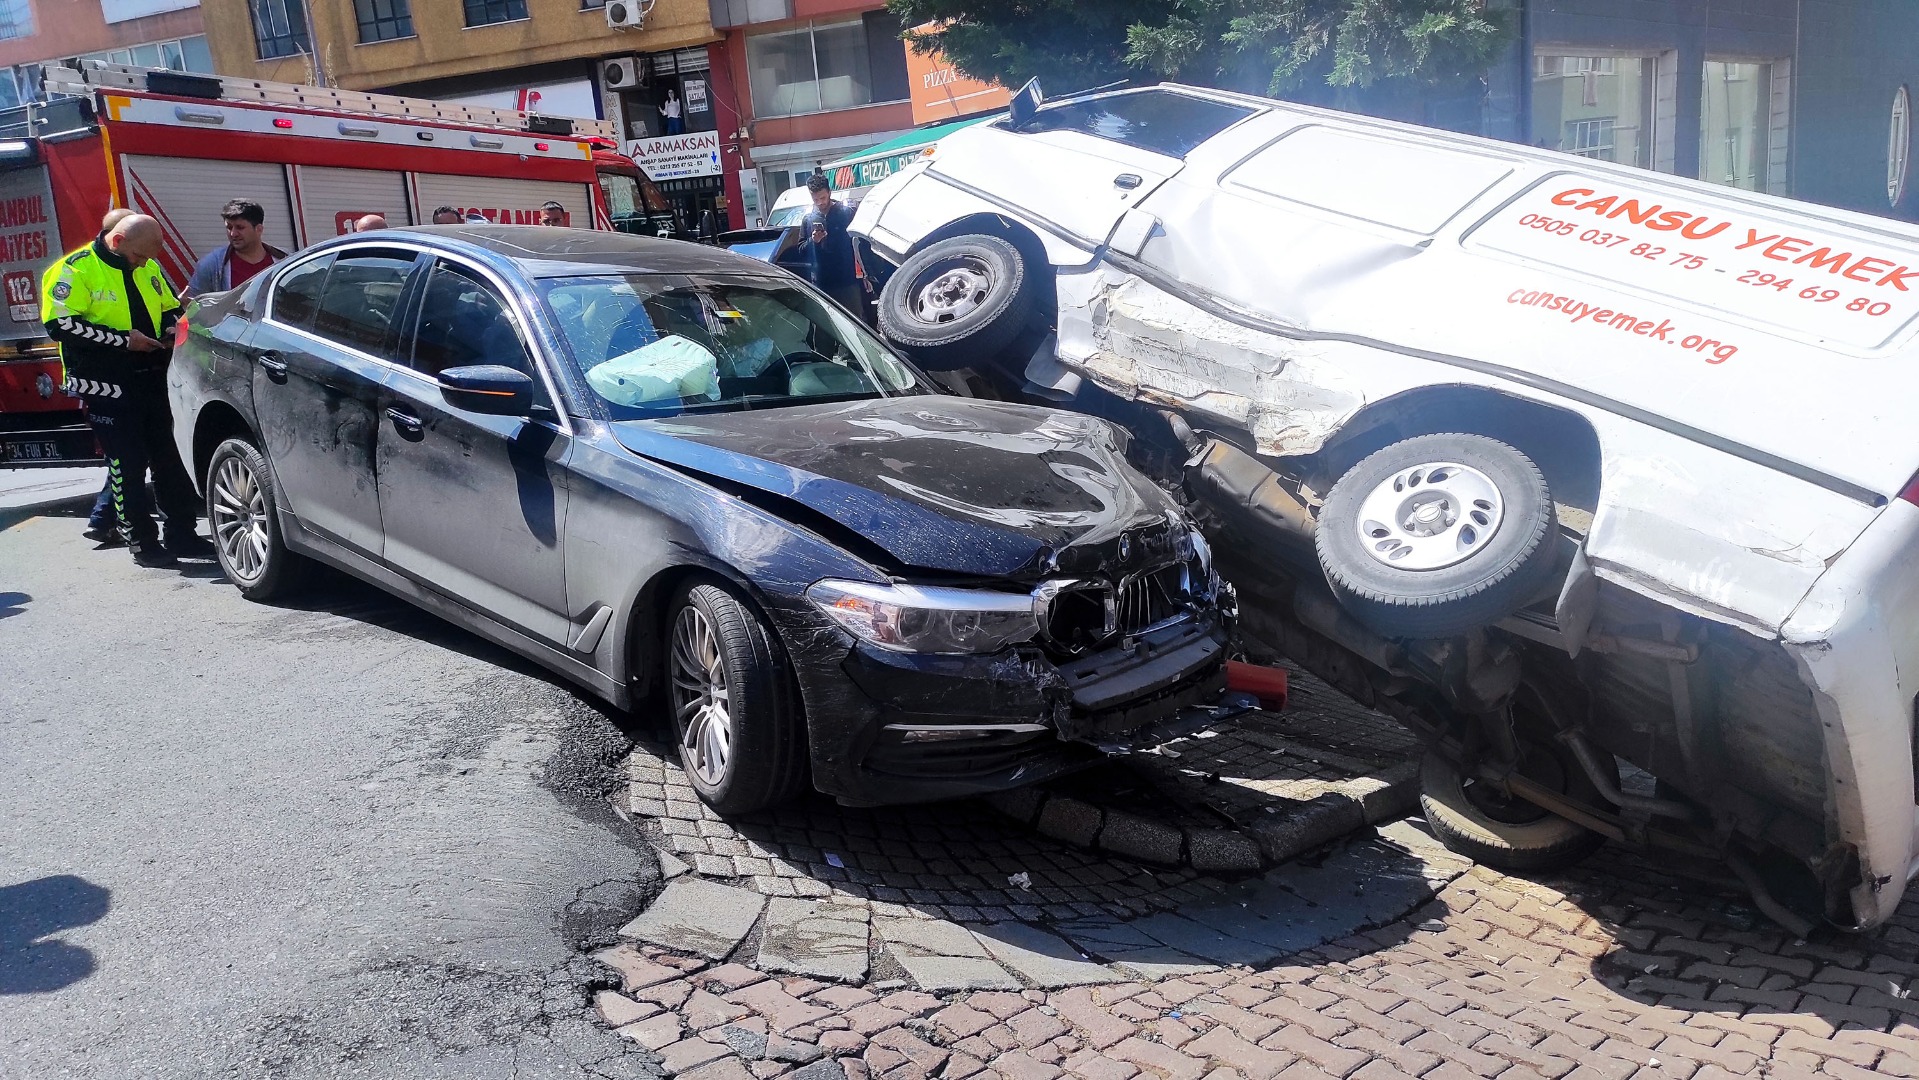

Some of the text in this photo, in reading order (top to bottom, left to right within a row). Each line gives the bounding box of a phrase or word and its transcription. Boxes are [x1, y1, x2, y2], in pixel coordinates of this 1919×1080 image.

[647, 135, 716, 155] ARMAKSAN
[1519, 213, 1577, 238] 0505
[1579, 228, 1629, 249] 037
[1630, 242, 1667, 261] 82
[1669, 252, 1707, 270] 75
[1737, 268, 1792, 292] 294
[1798, 285, 1840, 304] 69
[1845, 297, 1892, 317] 80
[1551, 187, 1919, 292] CANSU YEMEK
[8, 276, 33, 302] 112
[1506, 285, 1739, 365] cansuyemek.org
[11, 444, 23, 458] 34
